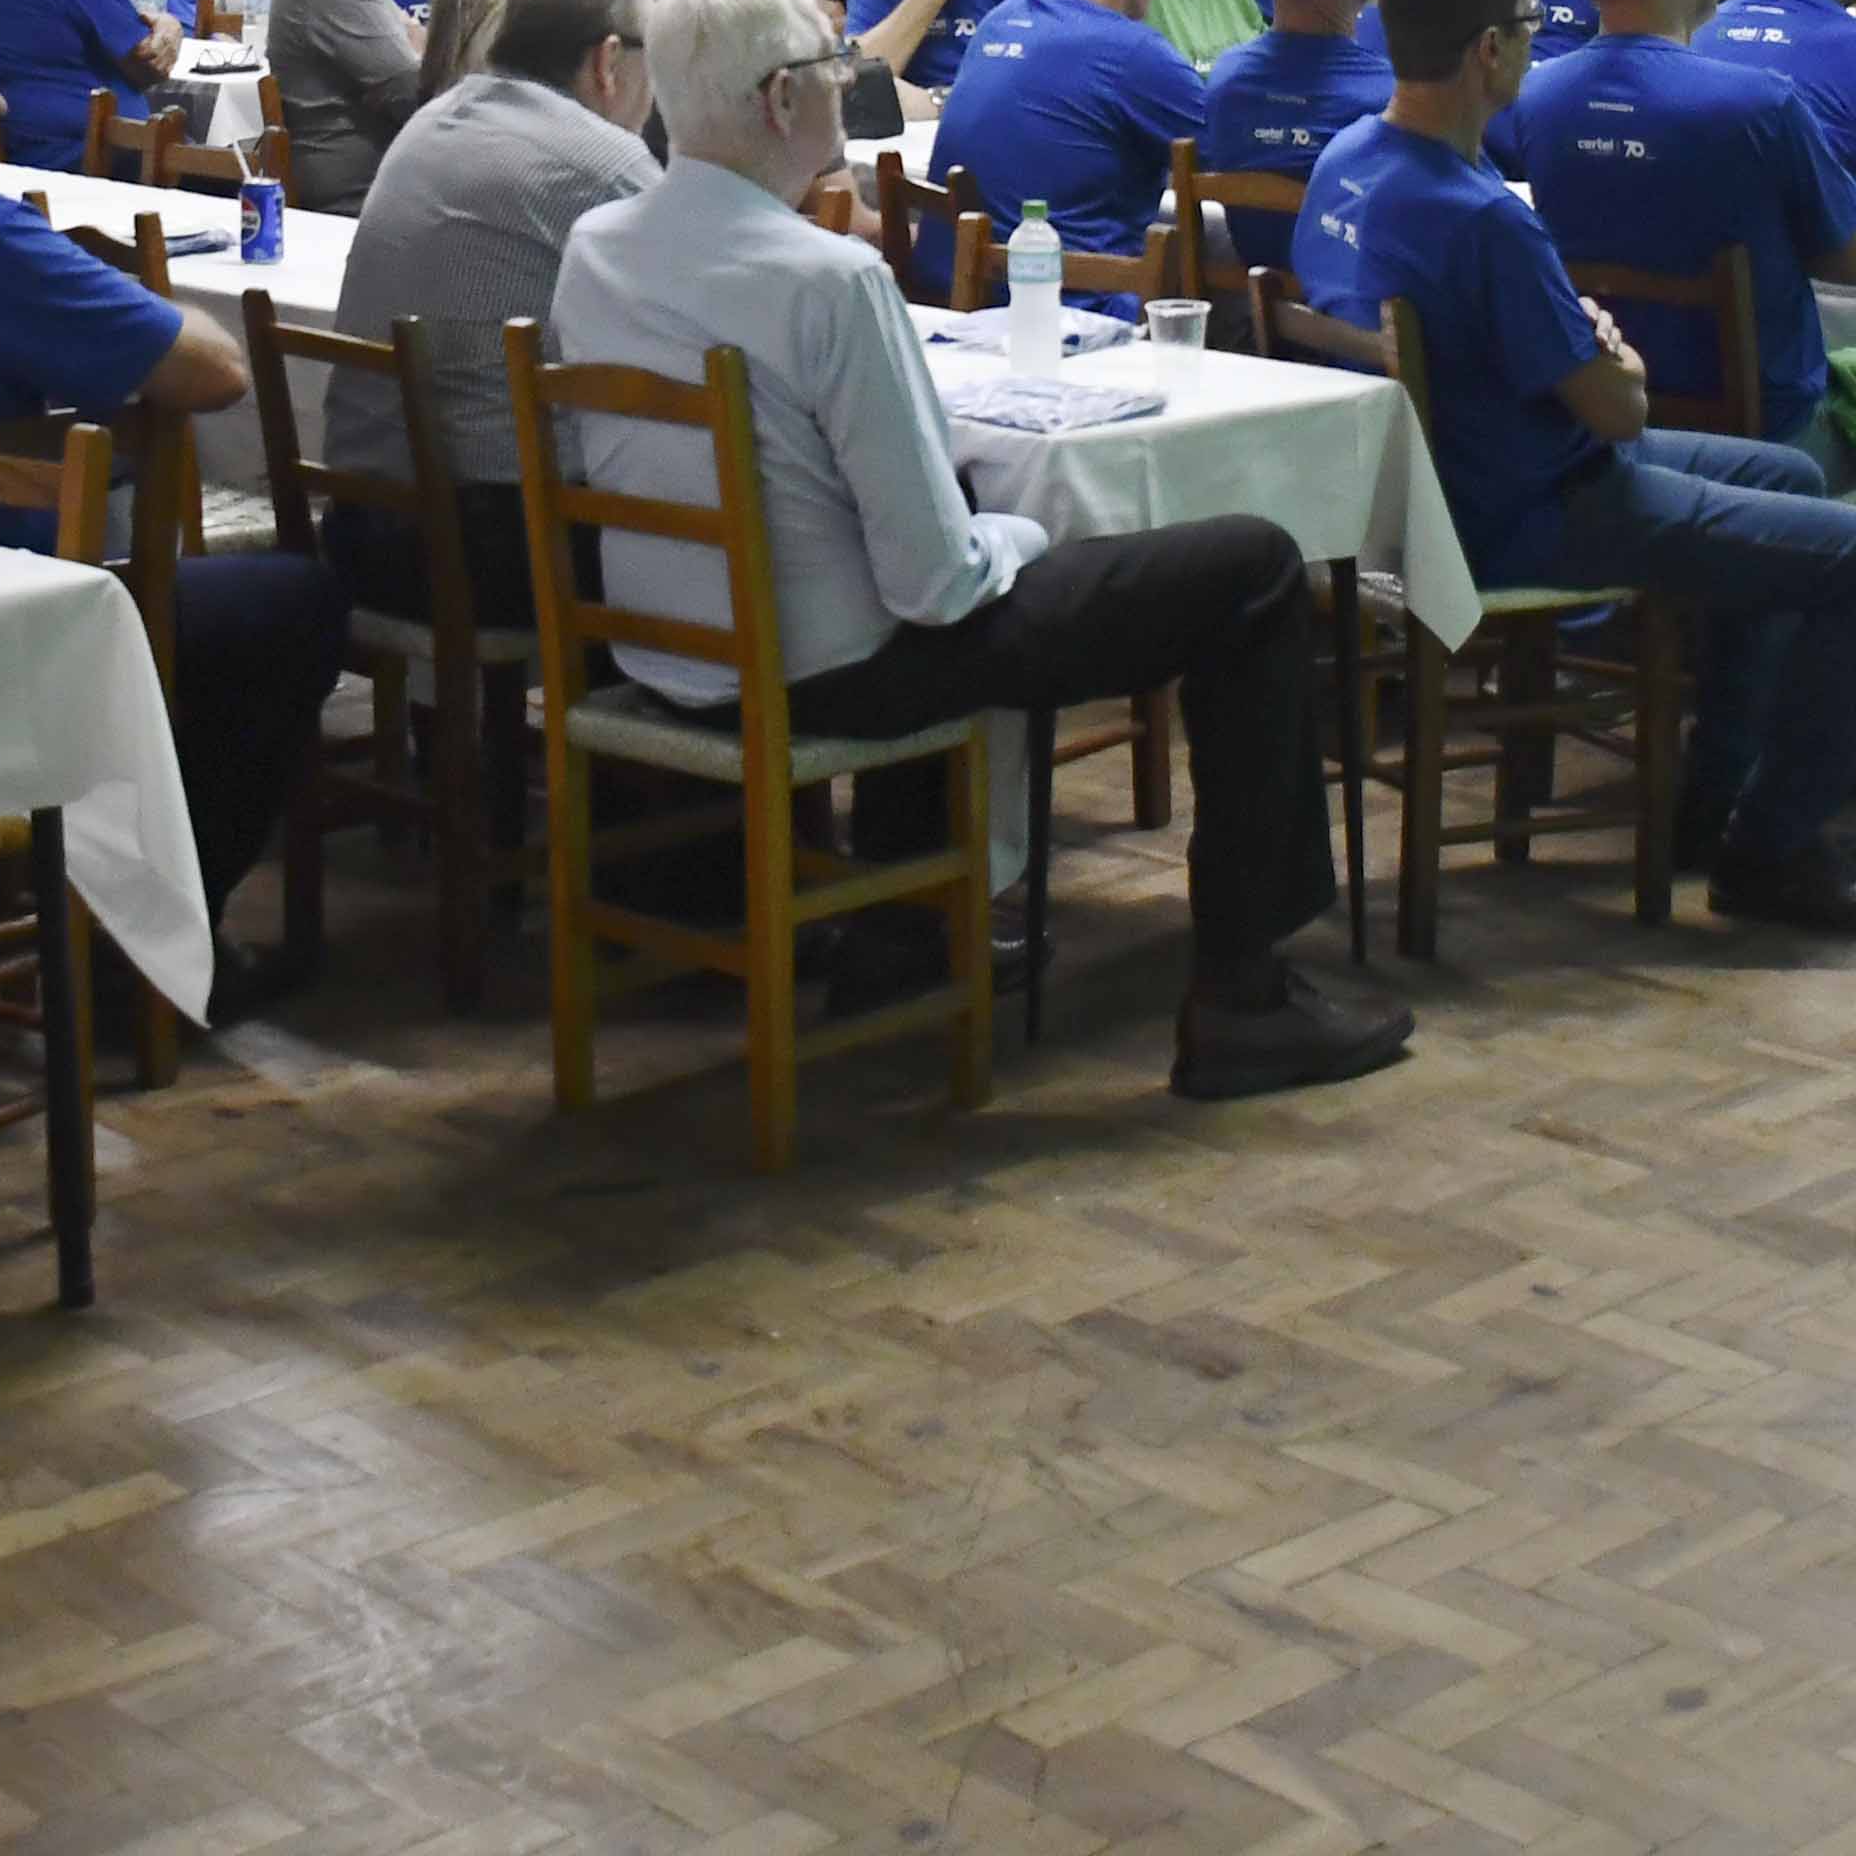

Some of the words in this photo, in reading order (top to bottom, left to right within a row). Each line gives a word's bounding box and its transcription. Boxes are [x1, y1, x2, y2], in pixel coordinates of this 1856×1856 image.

[1550, 6, 1573, 24] 70
[1762, 28, 1783, 42] 70
[1291, 128, 1310, 144] 70
[1577, 137, 1613, 151] certel
[1623, 140, 1645, 158] 70
